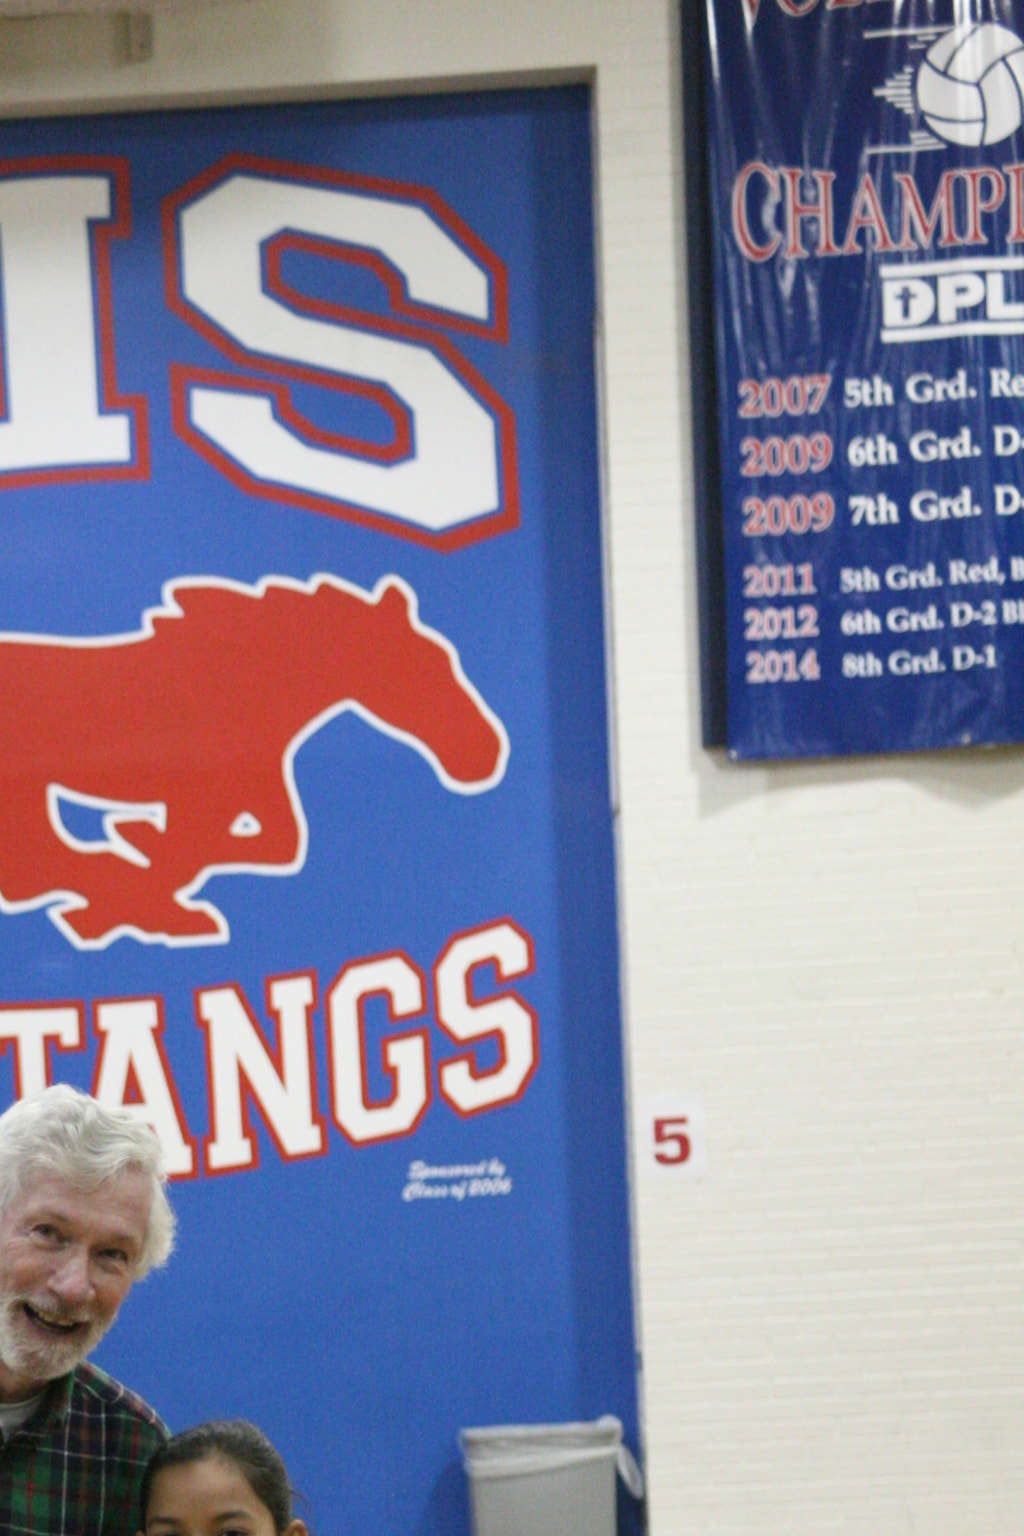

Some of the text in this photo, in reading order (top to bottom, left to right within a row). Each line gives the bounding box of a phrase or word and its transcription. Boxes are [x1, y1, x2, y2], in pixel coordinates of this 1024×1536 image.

[882, 270, 1024, 330] DPL
[737, 373, 832, 418] 2007
[843, 374, 895, 409] 5th
[905, 368, 977, 404] Grd.
[740, 431, 834, 478] 2009
[847, 432, 899, 468] 6th
[909, 426, 982, 463] Grd.
[741, 491, 835, 537] 2009
[848, 492, 900, 527] 7th
[910, 485, 982, 522] Grd.
[742, 562, 817, 599] 2011
[839, 565, 880, 594] 5th
[885, 562, 942, 591] Grd.
[948, 556, 1006, 586] Red,
[743, 603, 821, 641] 2012
[840, 608, 883, 636] 6th
[886, 604, 944, 633] Grd.
[949, 600, 998, 629] D-2
[745, 643, 998, 685] 2014 8th Grd. D-1
[652, 1116, 692, 1166] 5
